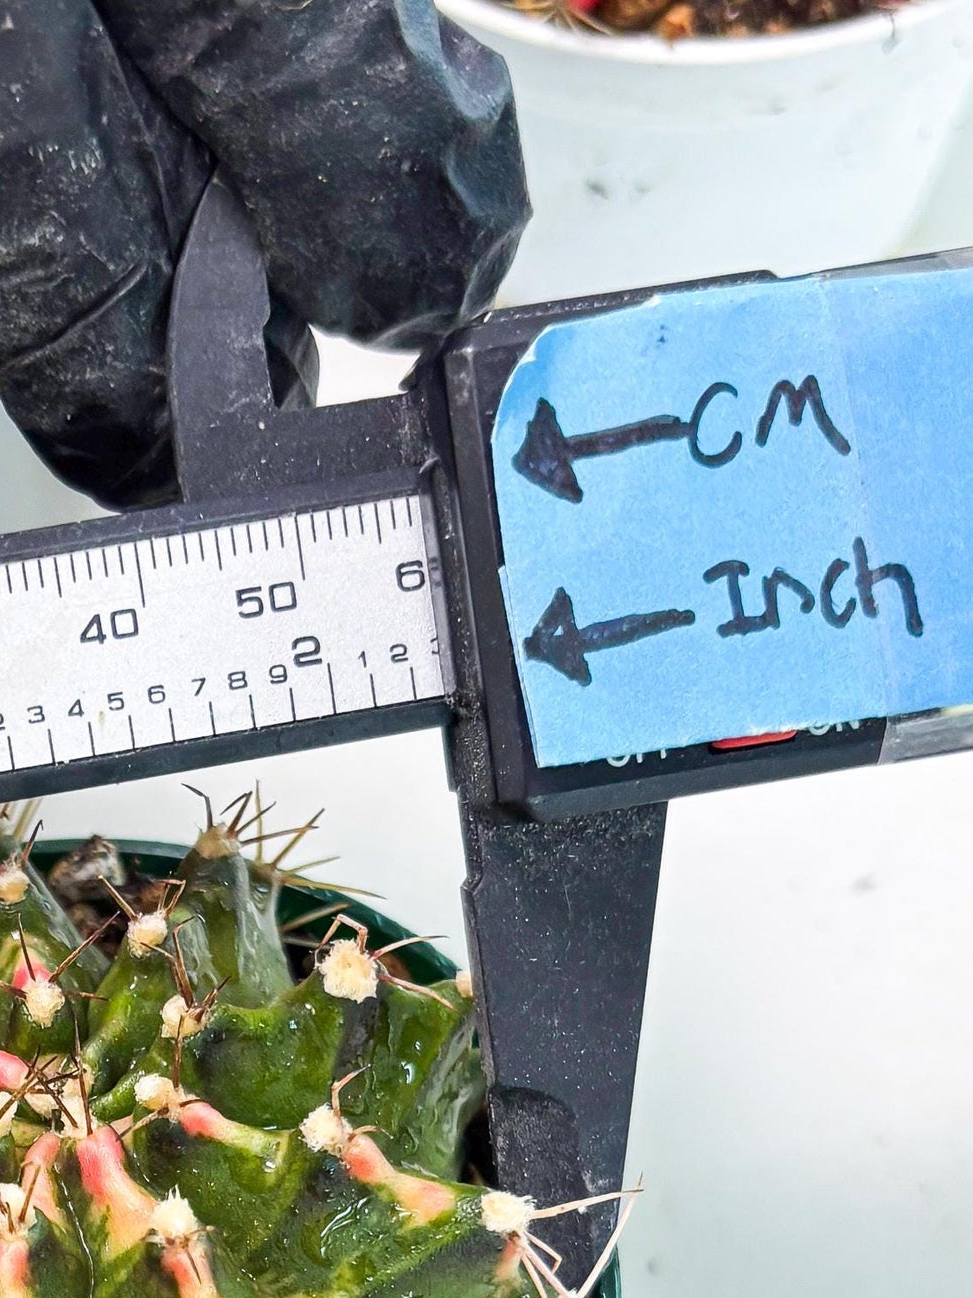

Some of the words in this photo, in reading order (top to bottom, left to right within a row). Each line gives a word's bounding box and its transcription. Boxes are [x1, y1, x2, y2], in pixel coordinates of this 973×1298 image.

[79, 608, 139, 644] 40
[235, 581, 298, 619] 50
[395, 559, 426, 593] 6
[703, 536, 923, 638] Inch
[27, 705, 46, 724] 3
[67, 698, 85, 717] 4
[107, 691, 125, 711] 5
[147, 684, 166, 704] 6
[191, 677, 206, 697] 7
[227, 670, 248, 691] 8
[268, 664, 288, 685] 9
[291, 635, 323, 668] 2
[357, 650, 367, 668] 1
[389, 643, 409, 663] 2
